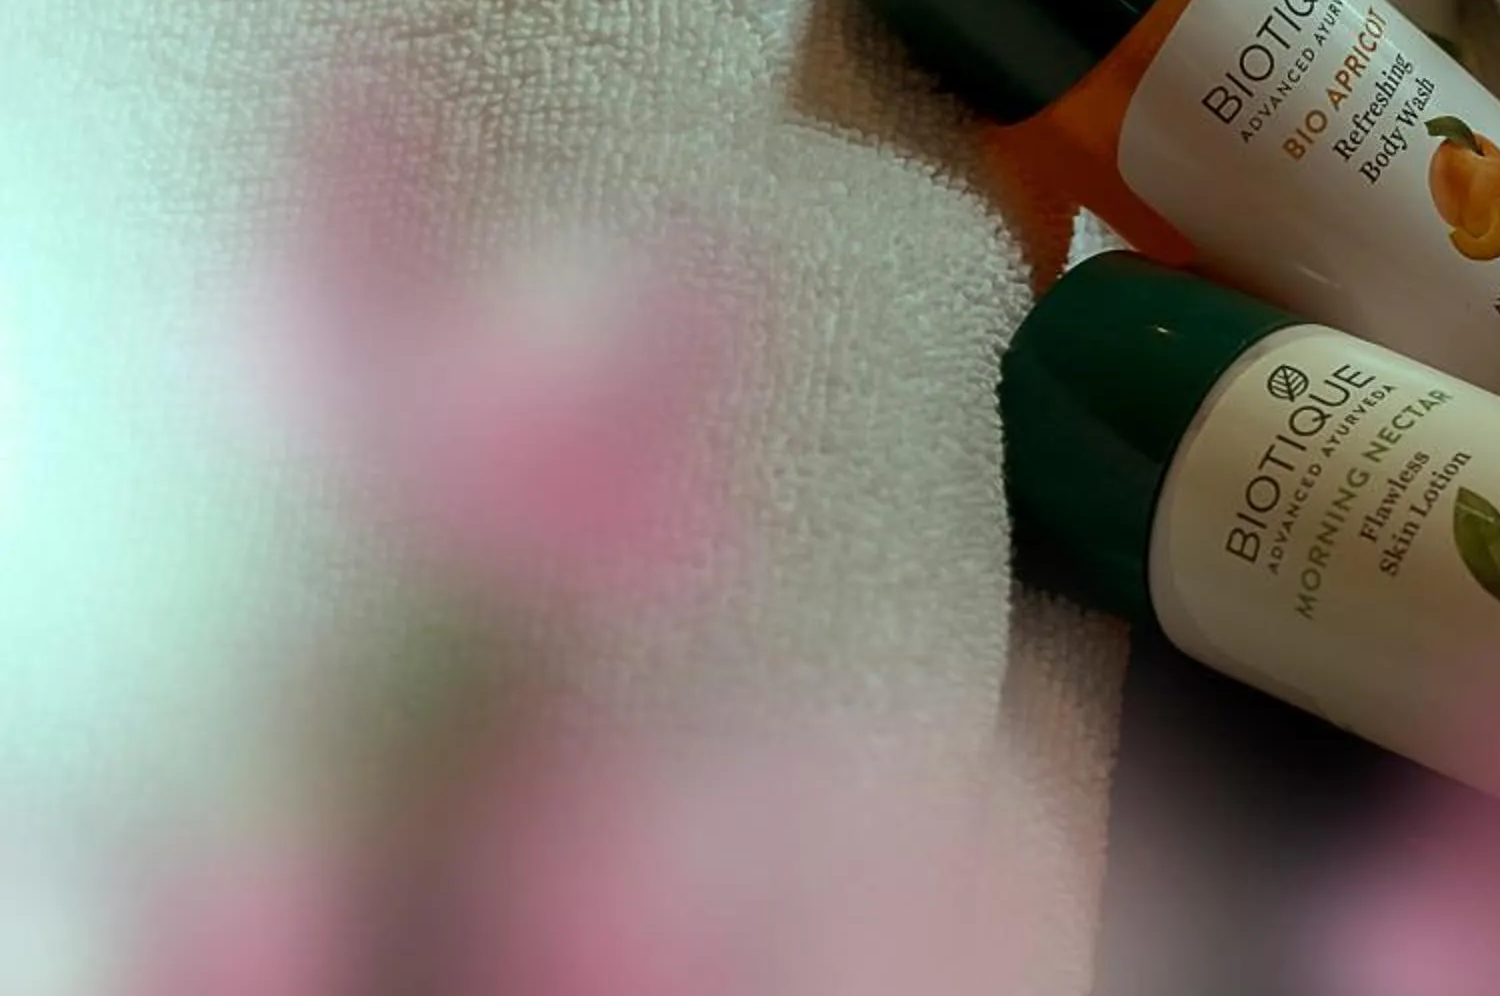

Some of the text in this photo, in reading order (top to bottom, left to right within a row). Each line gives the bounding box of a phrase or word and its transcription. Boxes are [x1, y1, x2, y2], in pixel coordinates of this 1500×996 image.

[1241, 47, 1315, 142] ADVANCED
[1283, 109, 1327, 162] BIO
[1325, 6, 1387, 111] APRICOT
[1332, 52, 1415, 162] Refreshing
[1359, 76, 1435, 184] Body Wash
[1225, 364, 1377, 564] BIOTIQUE
[1268, 384, 1396, 575] ADVANCED AYURVEDA
[1294, 388, 1455, 621] MORNING NECTAR
[1359, 451, 1431, 544] Flawless
[1379, 450, 1472, 577] Skin Lotion
